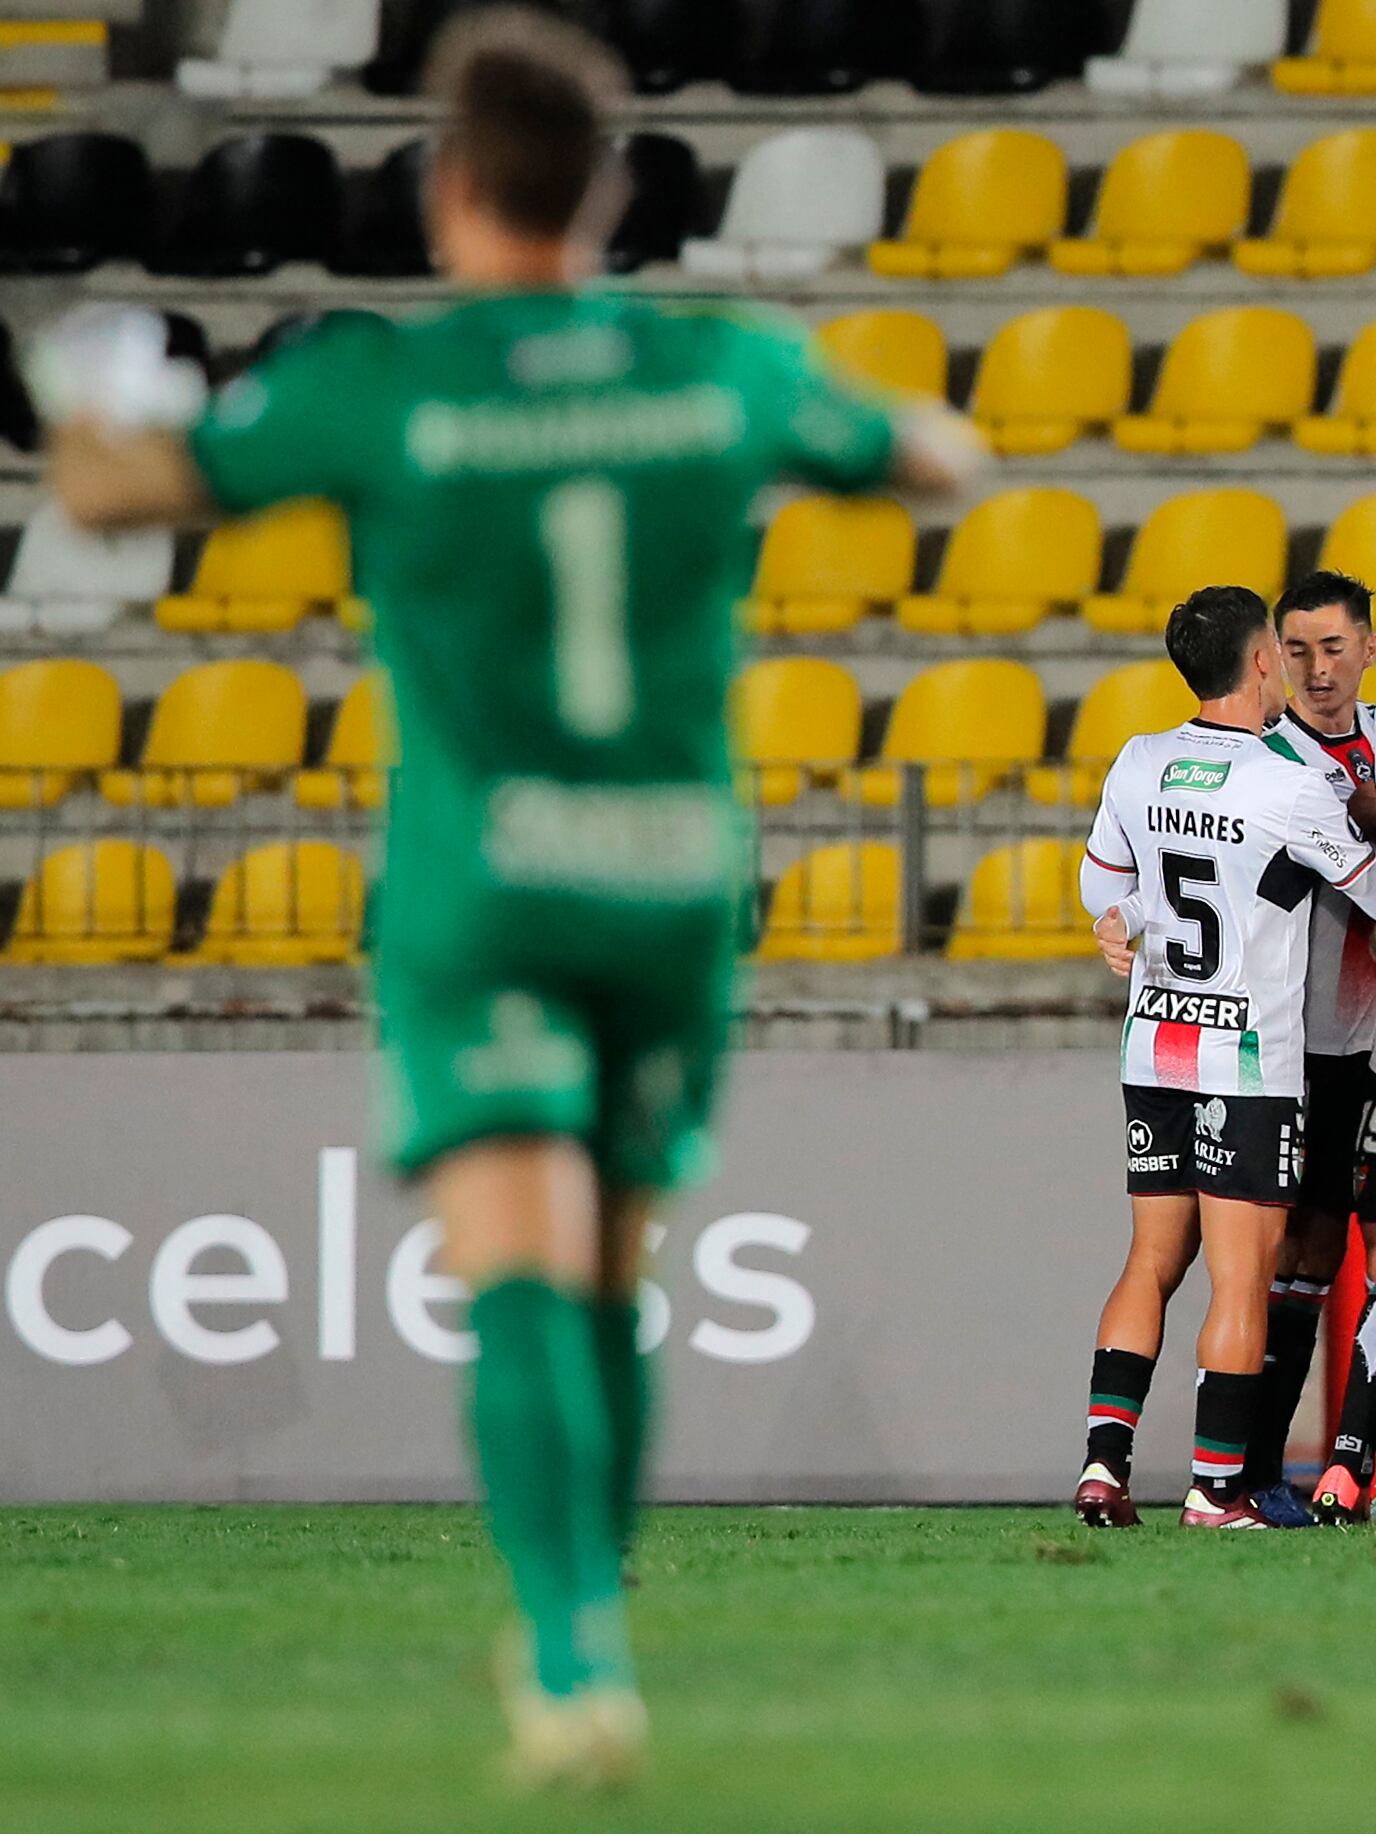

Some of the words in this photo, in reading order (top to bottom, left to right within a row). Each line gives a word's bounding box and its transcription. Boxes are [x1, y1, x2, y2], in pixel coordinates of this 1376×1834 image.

[538, 474, 638, 742] 1
[1164, 765, 1188, 782] San
[1185, 765, 1224, 785] Jorge
[1147, 805, 1245, 845] LINARES
[1158, 848, 1224, 983] 5
[1136, 987, 1240, 1029] KAYSER
[4, 1146, 817, 1365] celes
